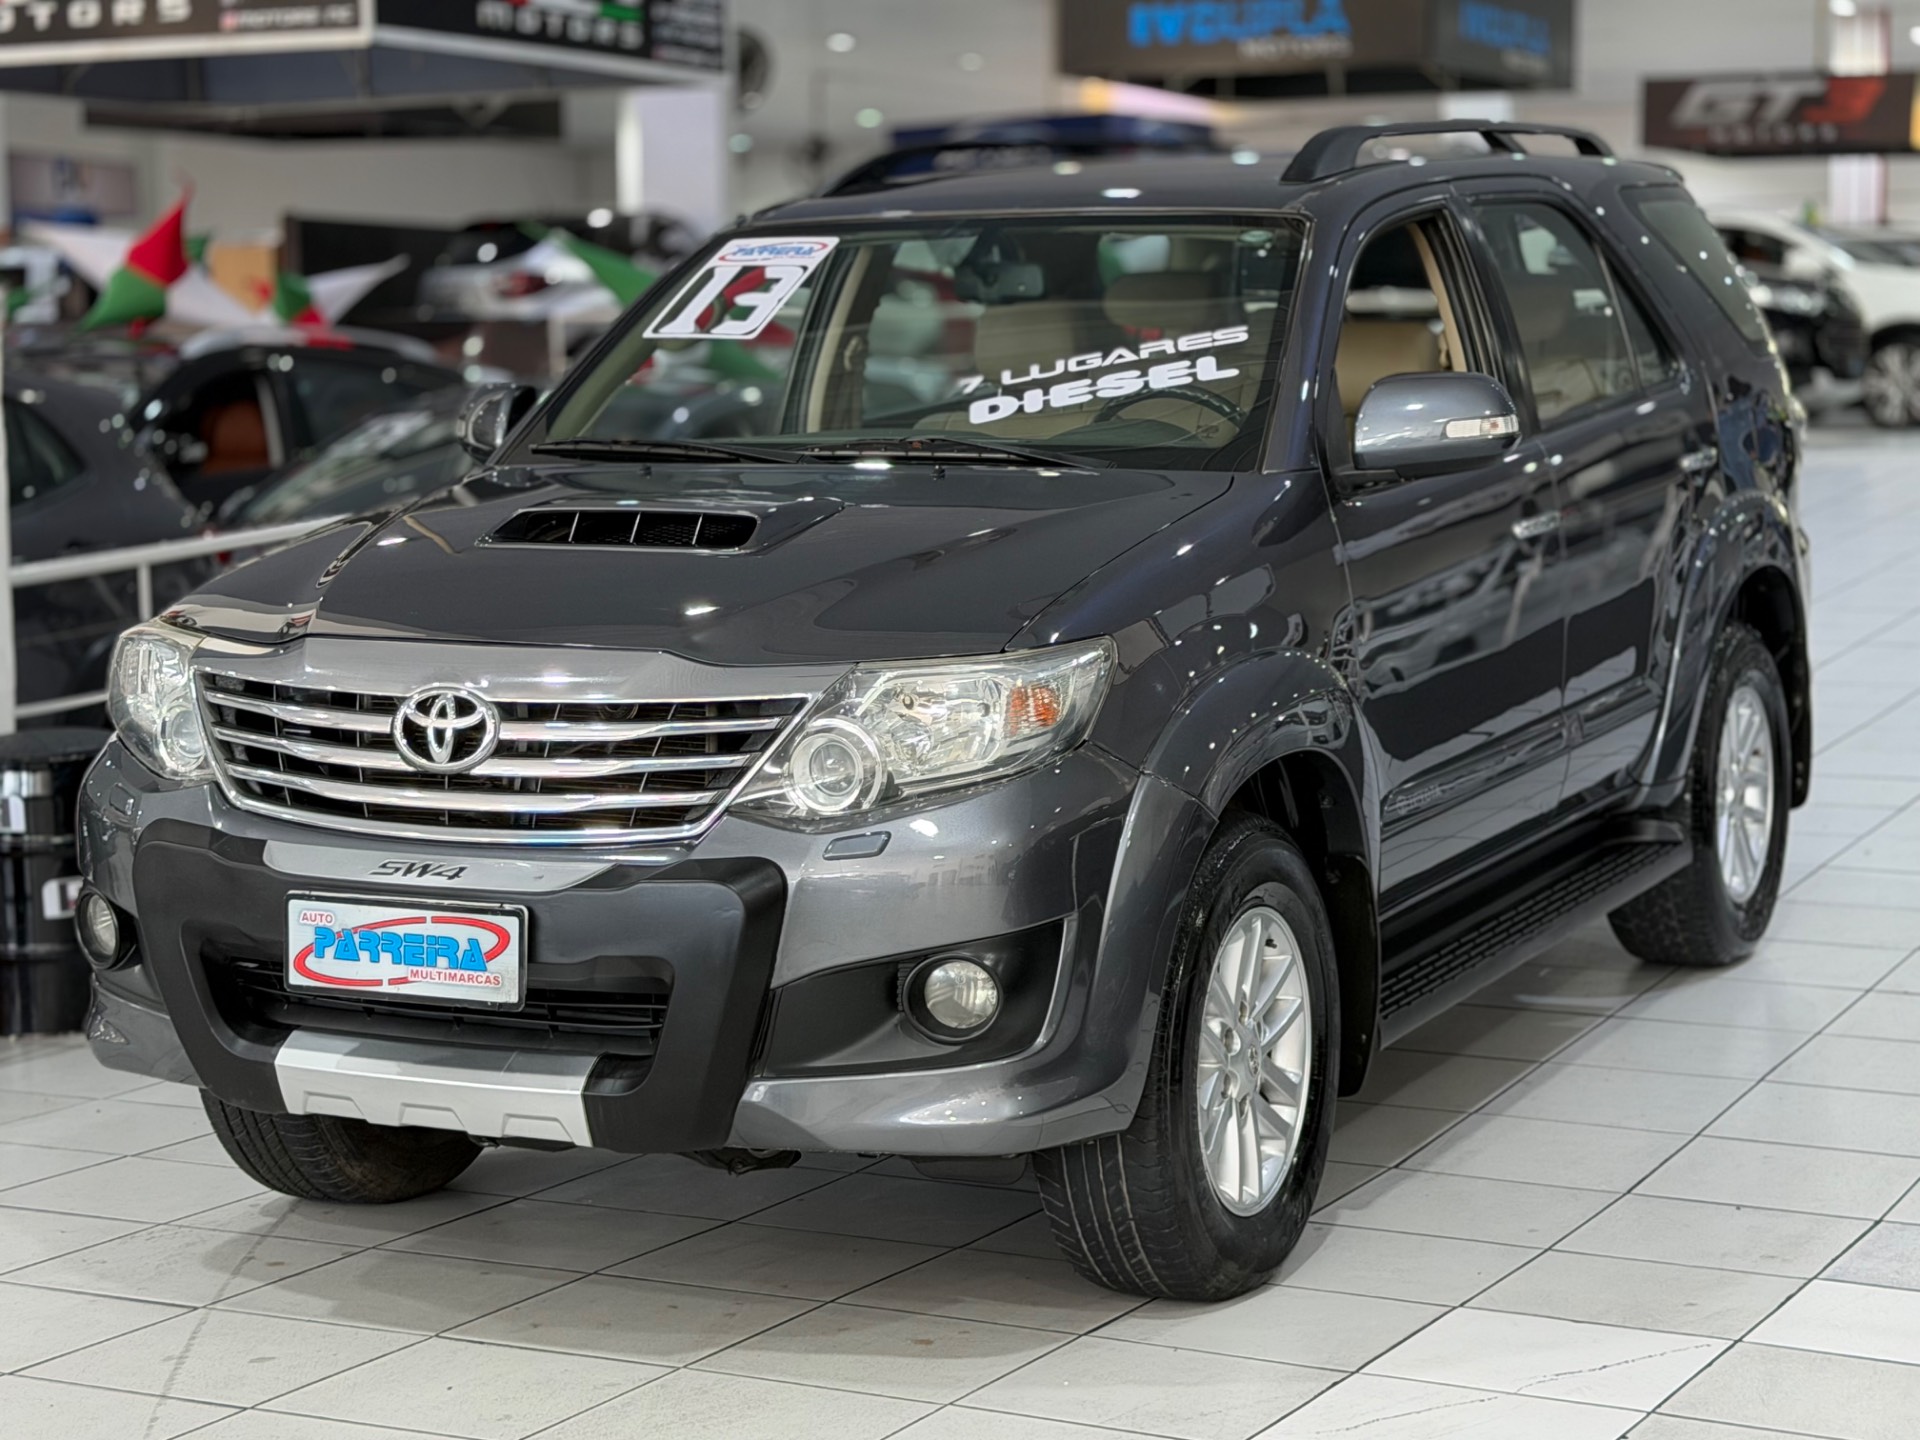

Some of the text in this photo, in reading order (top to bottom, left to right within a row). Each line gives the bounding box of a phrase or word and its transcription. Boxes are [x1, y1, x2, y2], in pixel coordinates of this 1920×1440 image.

[657, 265, 806, 335] 13
[1001, 325, 1249, 386] LUGARES
[968, 355, 1240, 425] DIESEL
[369, 859, 470, 881] SW4
[301, 911, 334, 925] AUTO
[313, 926, 488, 972] PARREIRA
[409, 968, 501, 987] MULTIMARCAS
